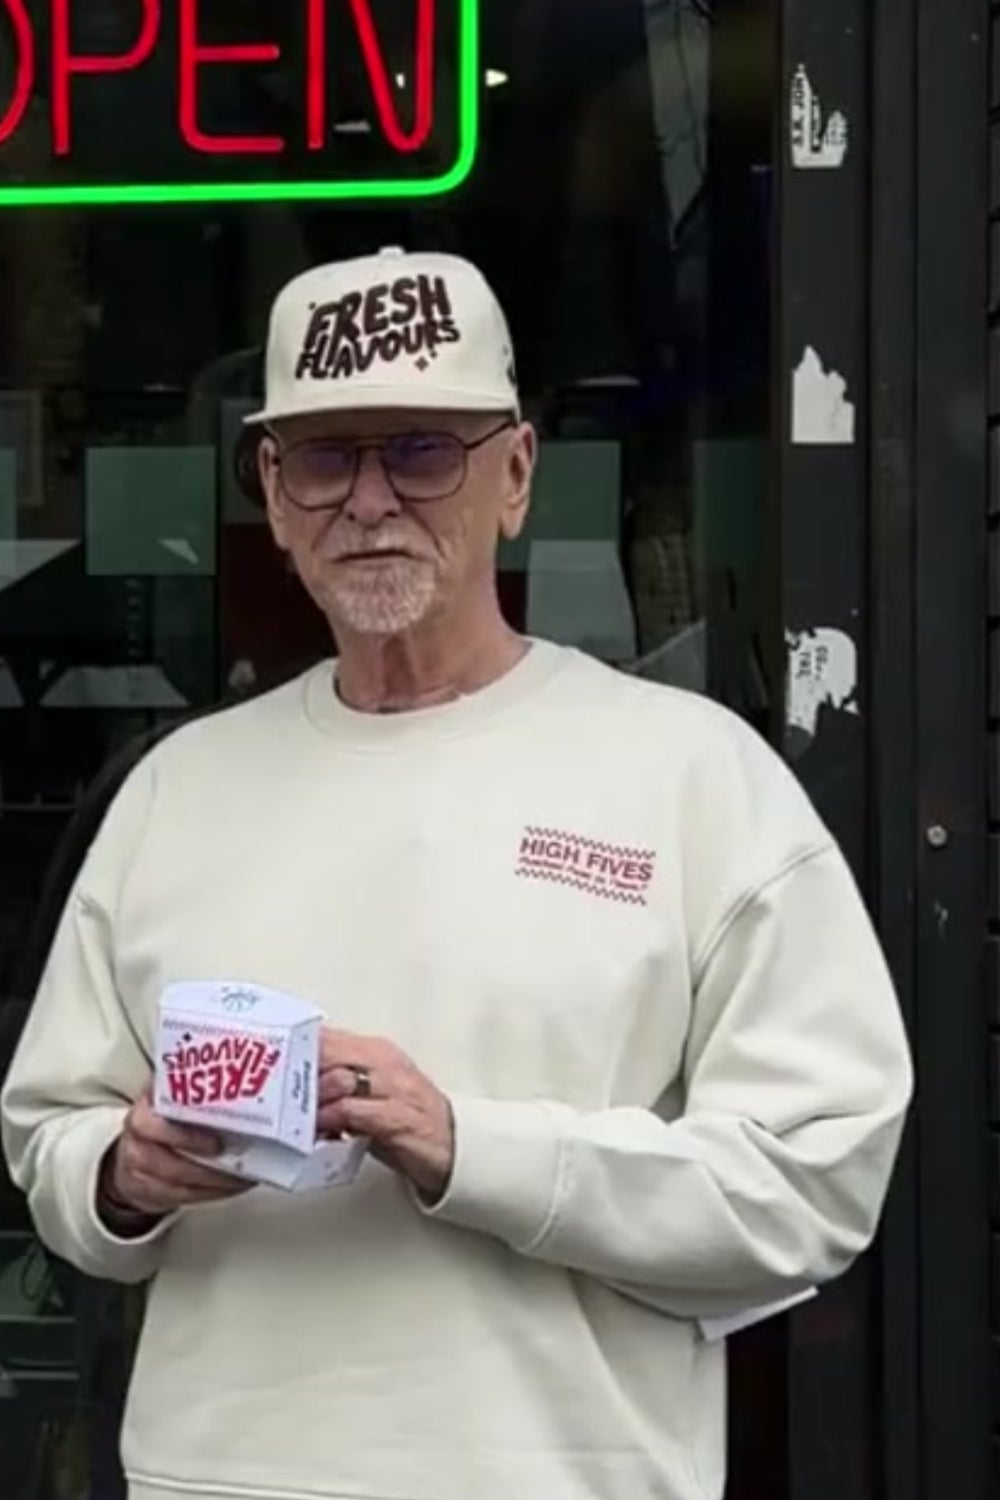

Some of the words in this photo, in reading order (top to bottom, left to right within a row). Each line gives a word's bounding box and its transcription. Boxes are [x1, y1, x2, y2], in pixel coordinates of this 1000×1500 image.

[304, 274, 452, 356] FRESH
[295, 319, 461, 380] FLAVOURS
[519, 837, 581, 864] HIGH
[586, 851, 654, 882] FIVES
[162, 1035, 281, 1075] FLAVOURS
[167, 1058, 270, 1106] FRESH
